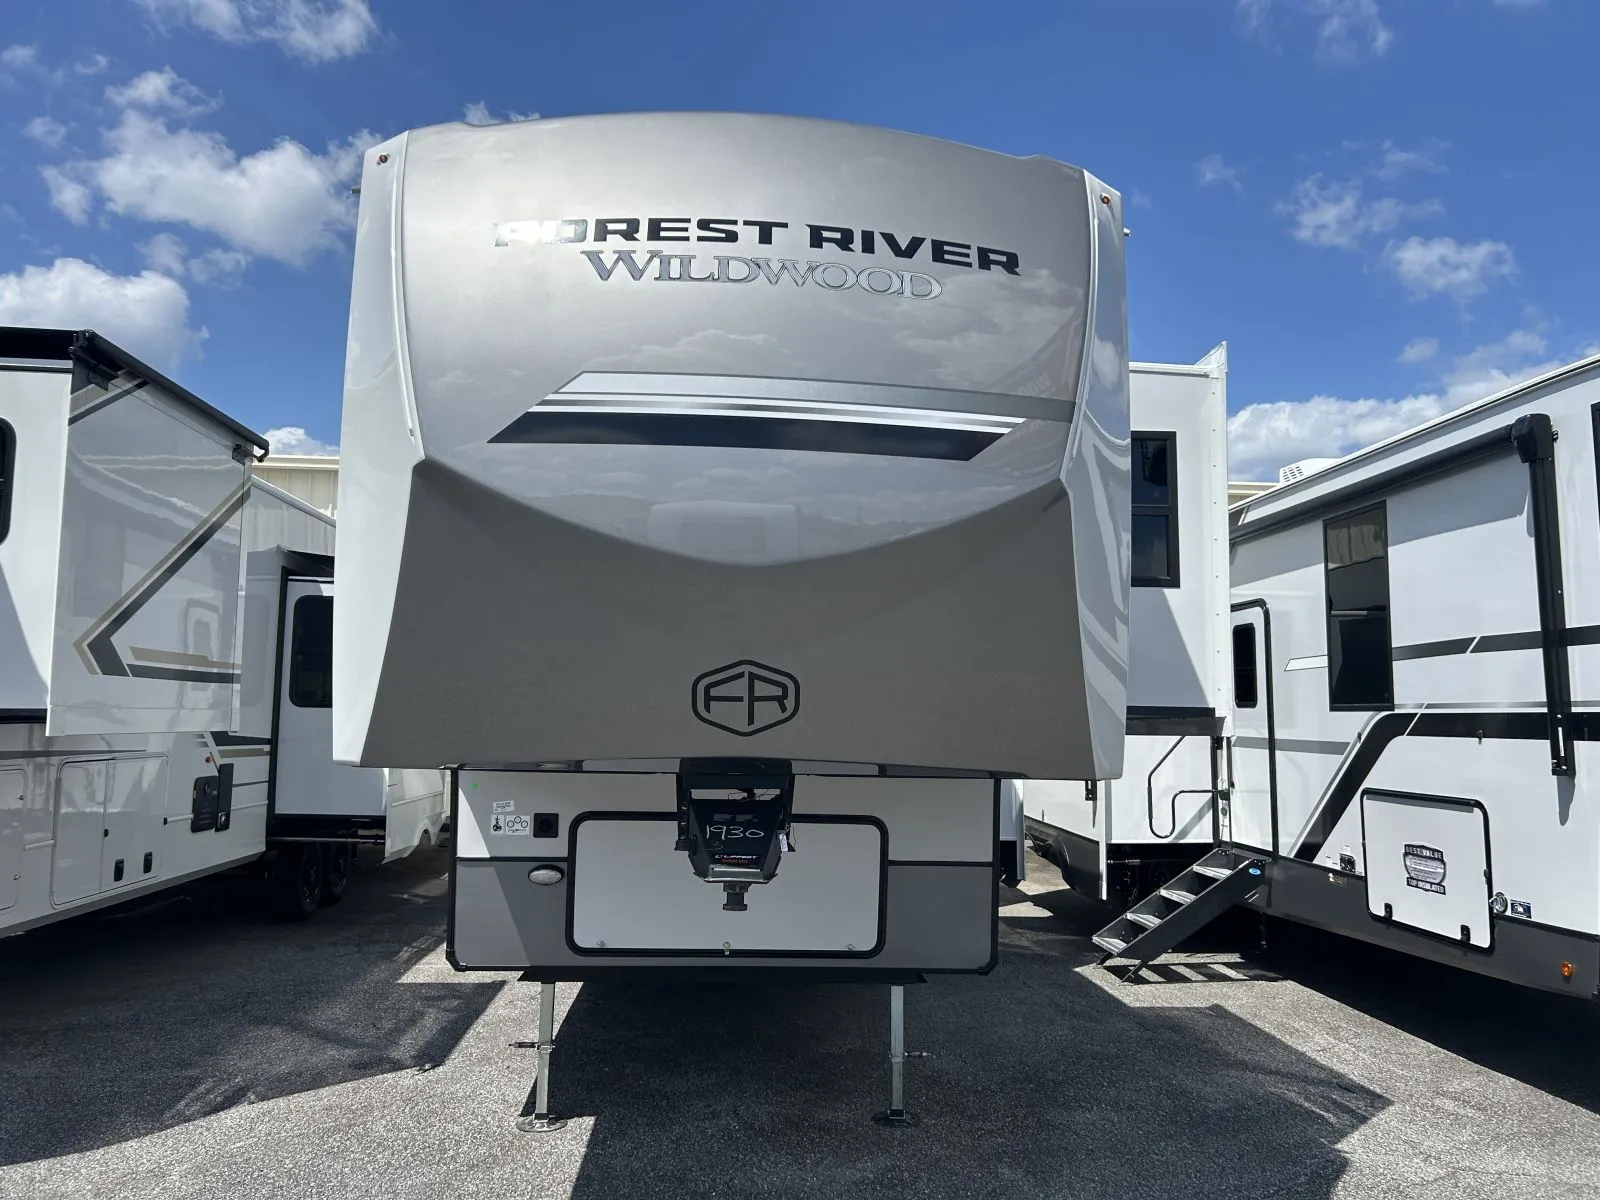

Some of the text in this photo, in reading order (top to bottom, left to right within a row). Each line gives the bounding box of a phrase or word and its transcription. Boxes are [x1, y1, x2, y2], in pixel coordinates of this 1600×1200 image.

[493, 217, 1021, 276] OREST RIVER
[580, 249, 943, 300] WILDWOOD
[706, 824, 765, 840] 1930
[1422, 849, 1442, 859] VALUE
